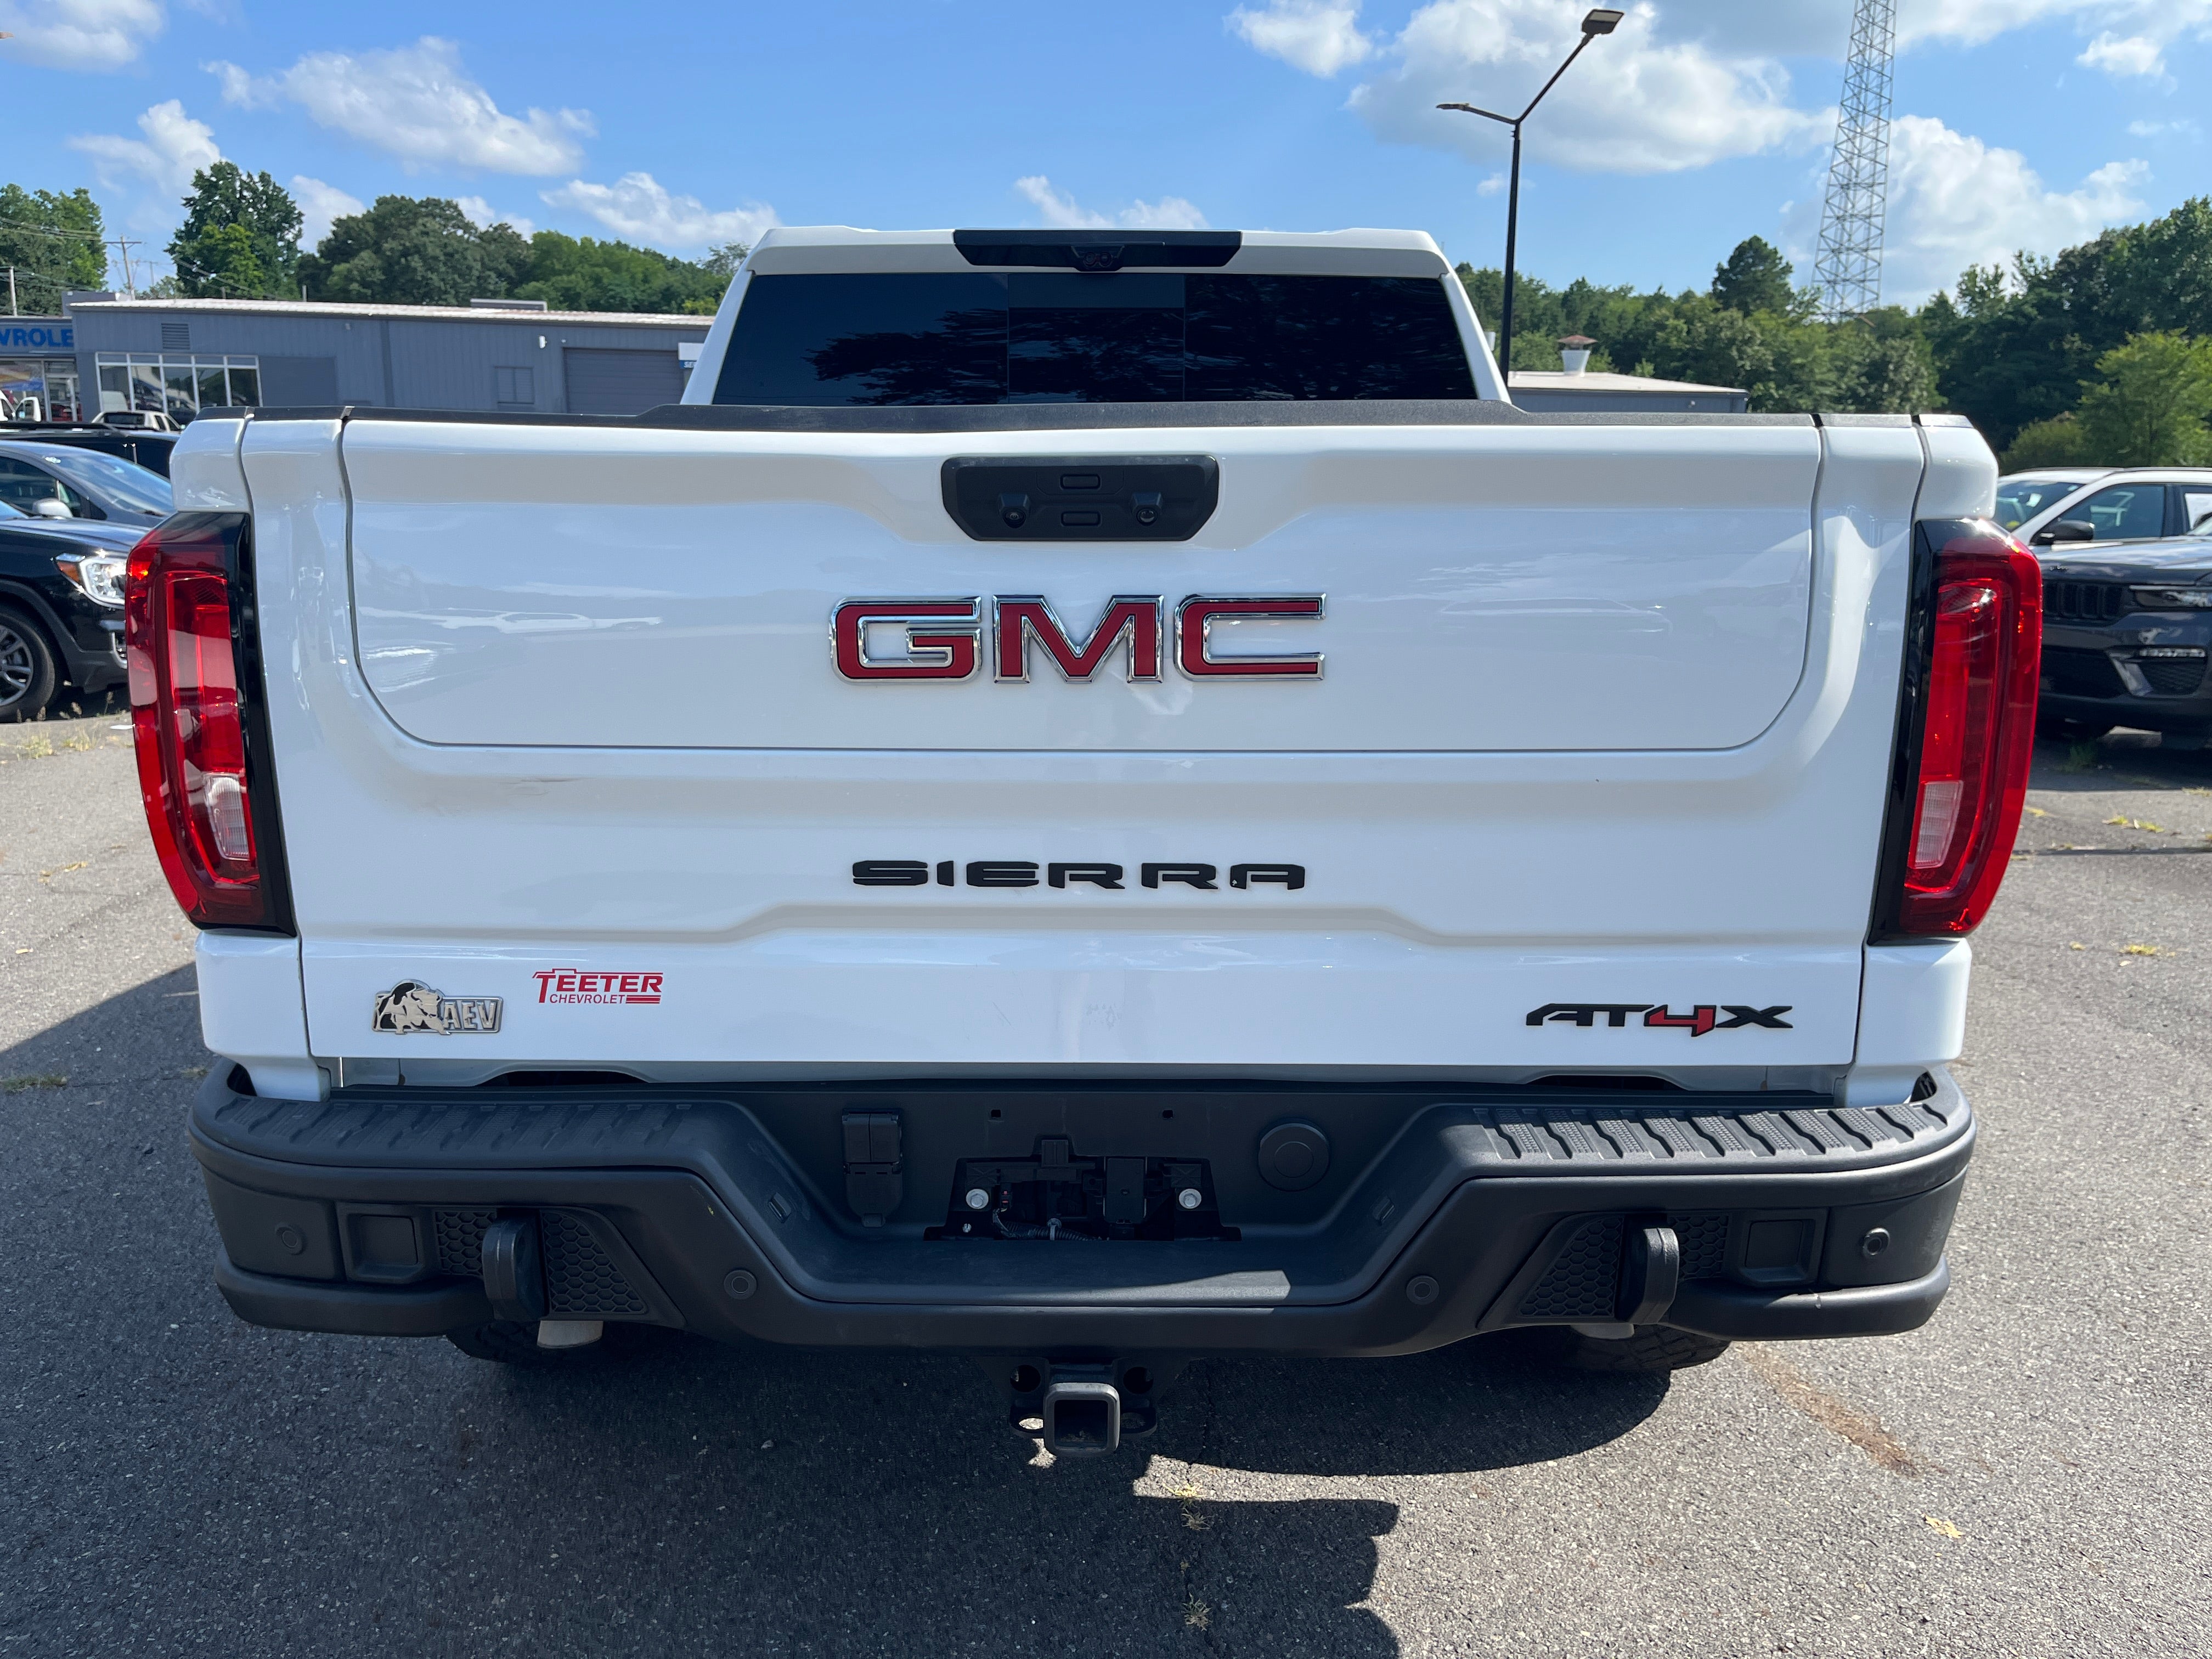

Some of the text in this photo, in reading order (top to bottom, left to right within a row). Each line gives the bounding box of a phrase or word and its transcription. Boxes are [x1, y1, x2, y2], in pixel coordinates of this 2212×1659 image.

[830, 593, 1328, 684] GMC
[852, 860, 1306, 890] SIERRA
[533, 973, 663, 1003] TEETER
[550, 994, 624, 1004] CHEVROLET
[443, 1001, 496, 1031] AEV
[1526, 1003, 1794, 1037] AT4X
